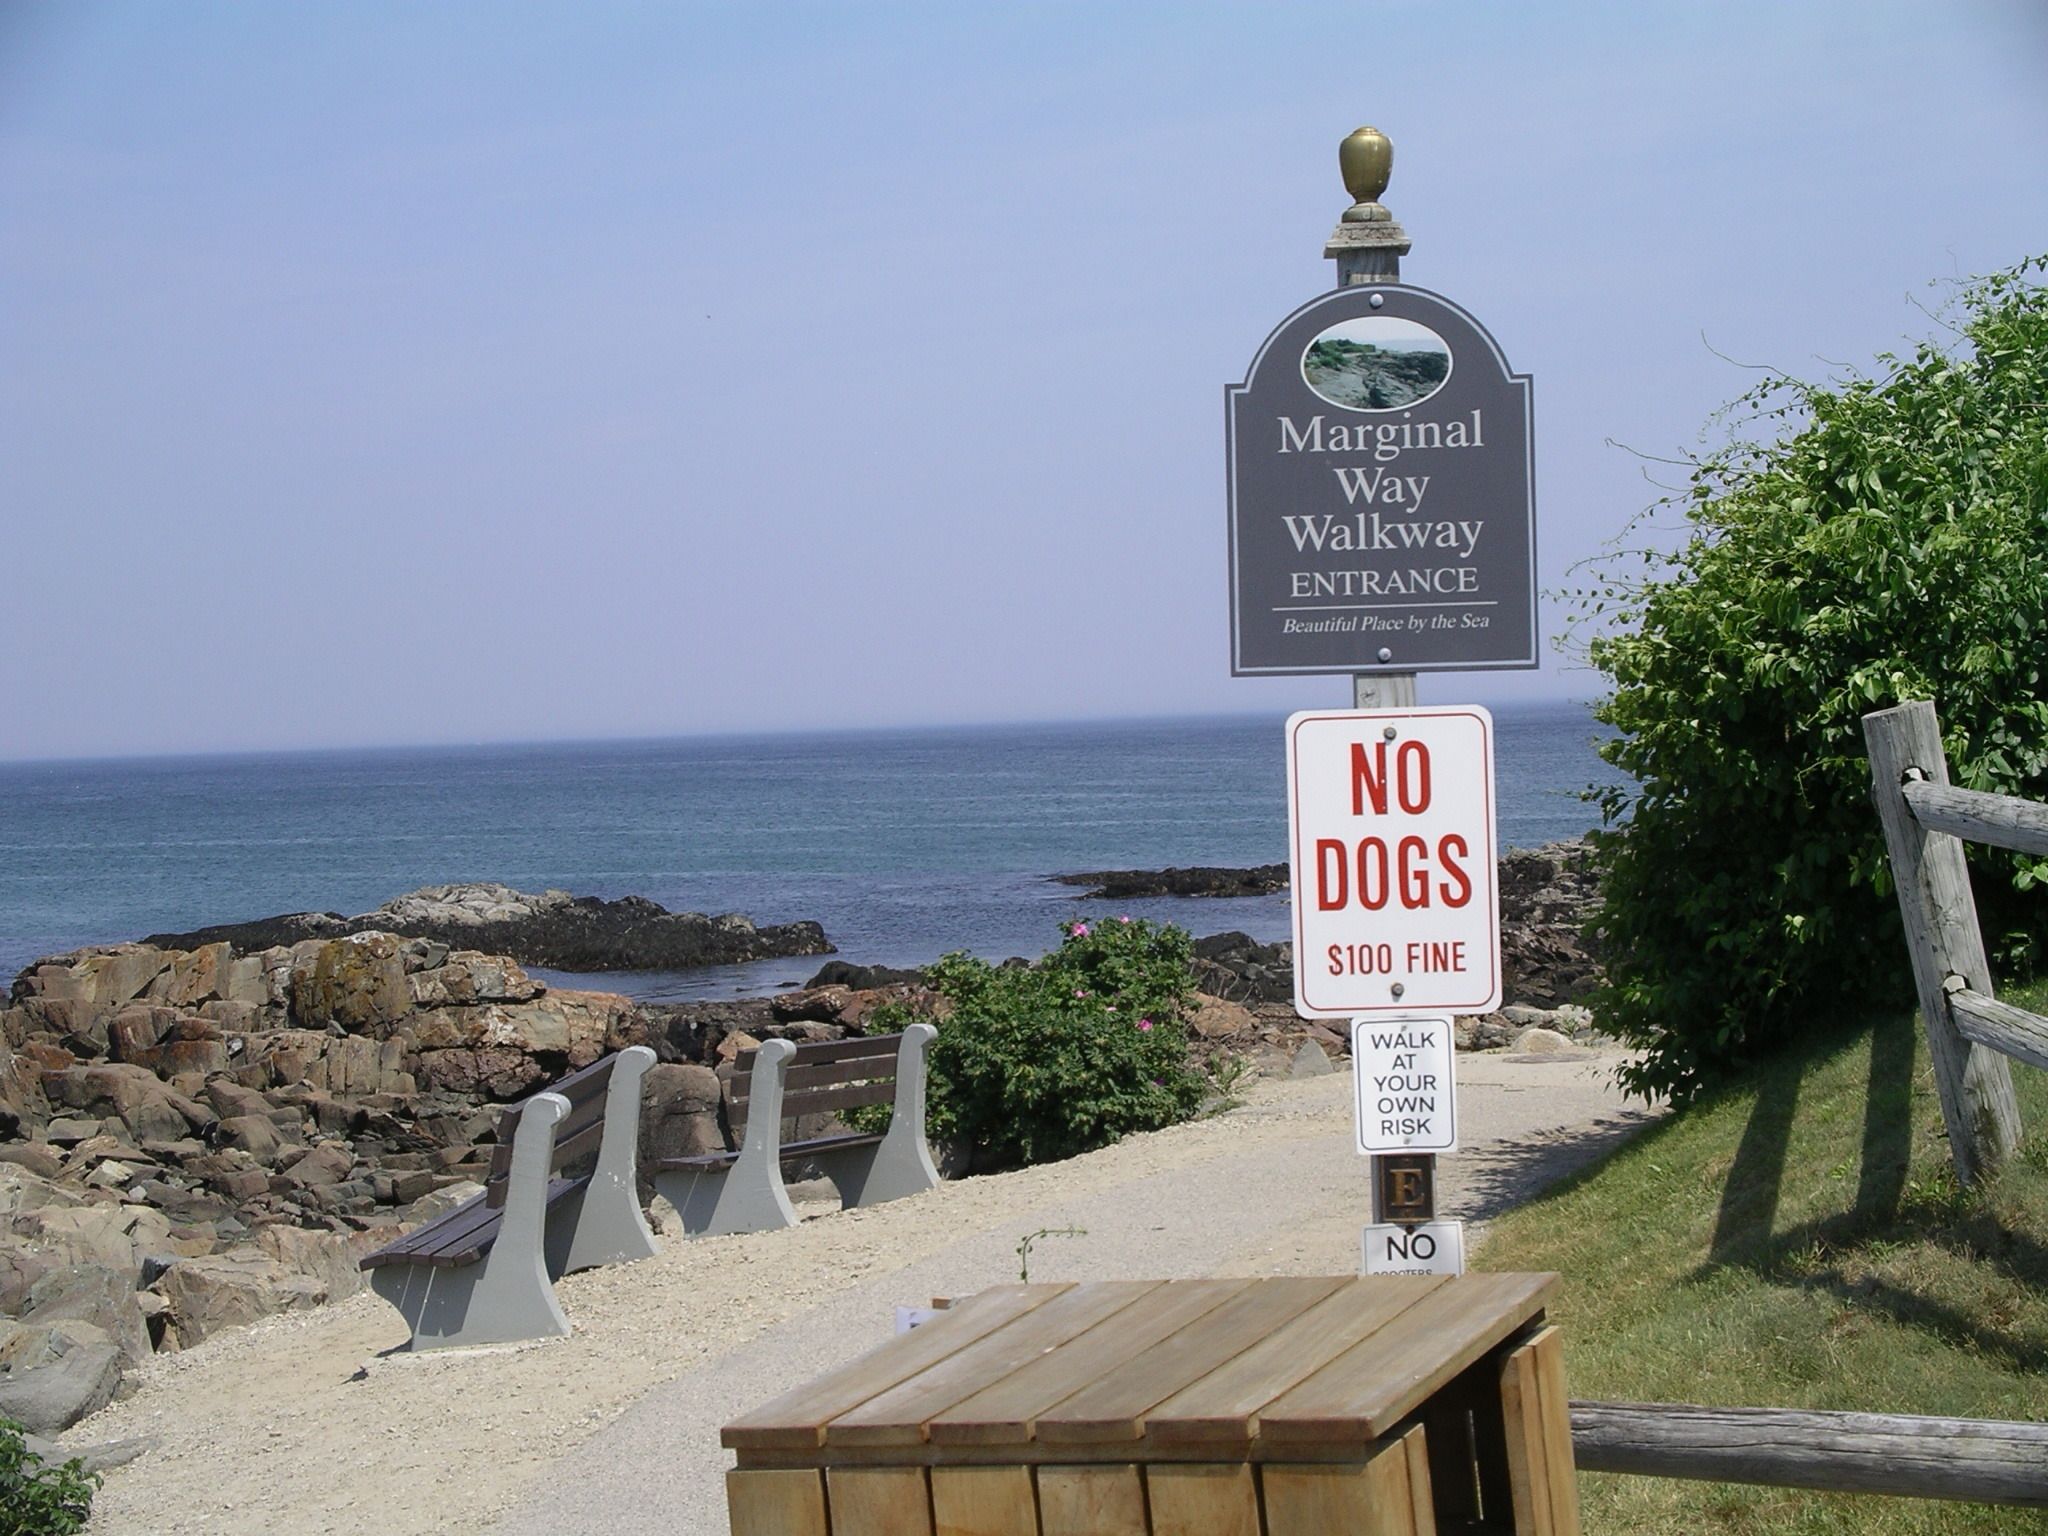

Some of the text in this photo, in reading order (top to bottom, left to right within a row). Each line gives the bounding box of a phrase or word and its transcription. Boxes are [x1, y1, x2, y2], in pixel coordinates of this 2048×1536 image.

[1277, 409, 1485, 461] Marginal
[1333, 466, 1430, 514] Way
[1281, 512, 1484, 557] Walkway
[1290, 567, 1479, 598] ENTRANCE
[1282, 613, 1490, 634] Beautiful Place by the Sea
[1350, 740, 1432, 815] NO
[1316, 834, 1472, 911] DOGS
[1328, 941, 1467, 977] $100 FINE
[1371, 1032, 1436, 1049] WALK
[1391, 1054, 1417, 1070] AT
[1373, 1075, 1437, 1092] YOUR
[1377, 1096, 1435, 1114] OWN
[1381, 1118, 1432, 1136] RISK
[1389, 1168, 1425, 1206] E
[1386, 1234, 1437, 1261] NO
